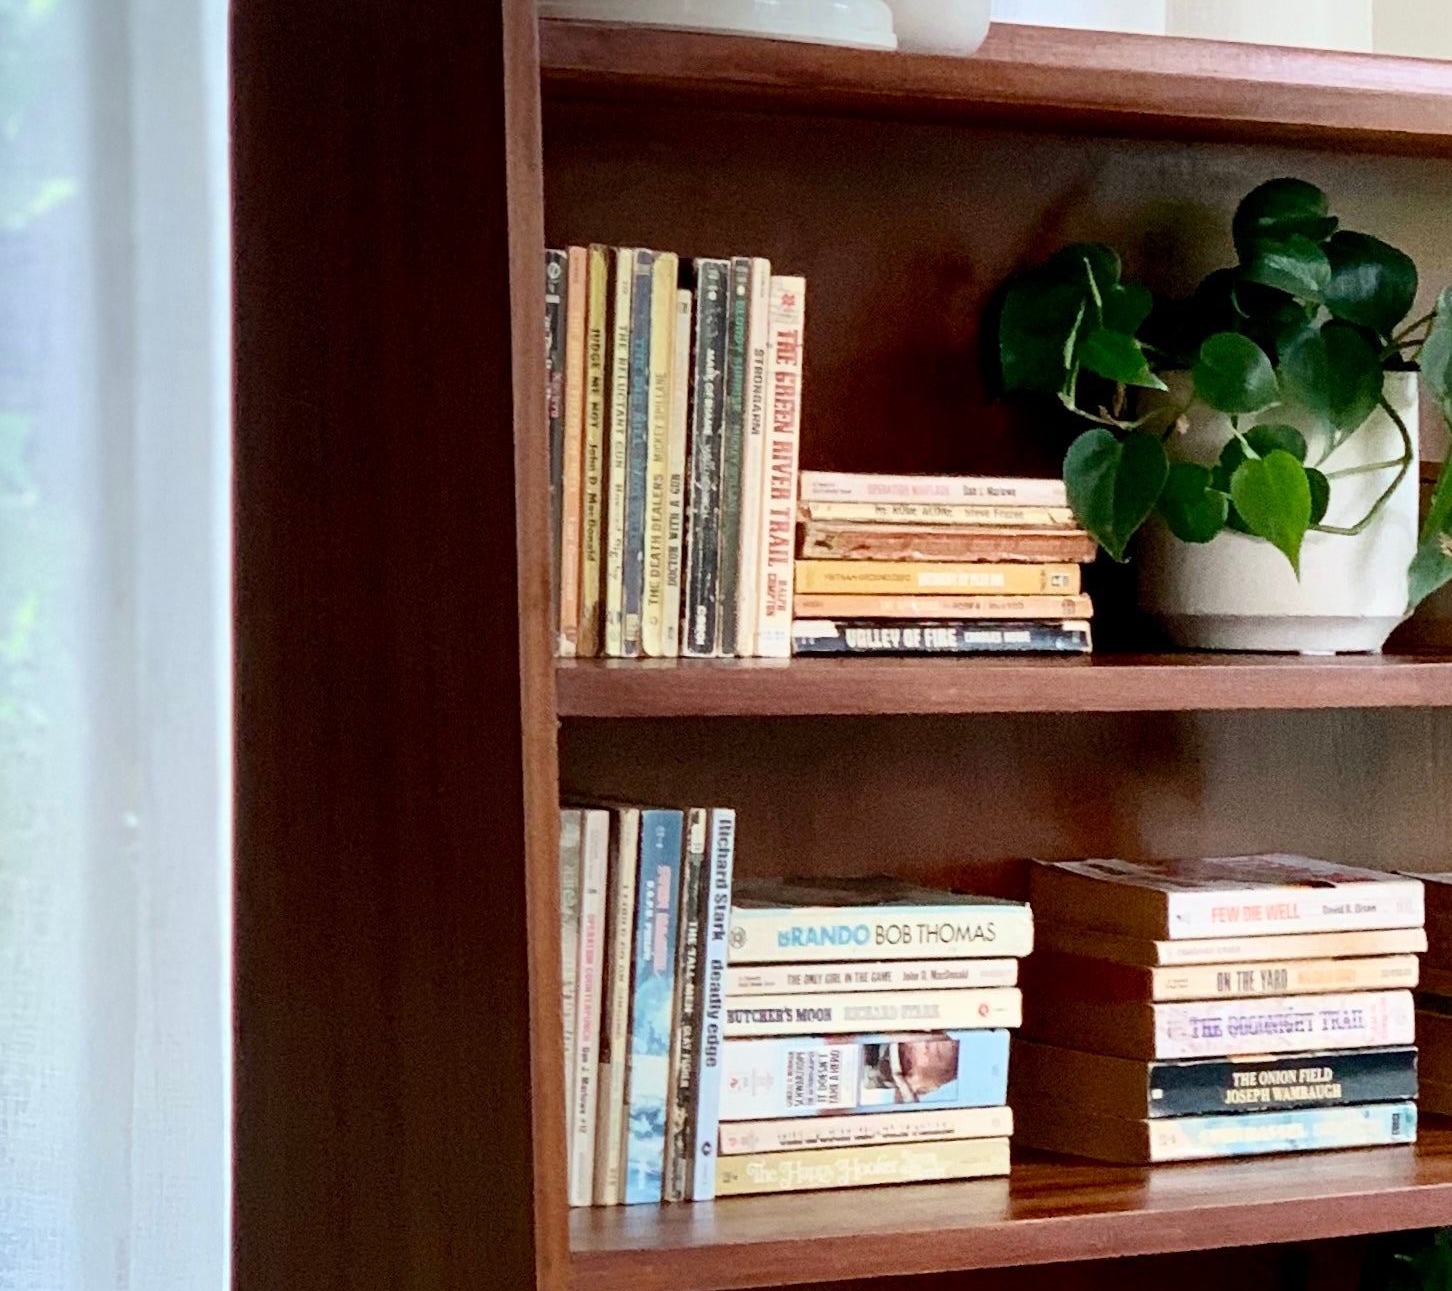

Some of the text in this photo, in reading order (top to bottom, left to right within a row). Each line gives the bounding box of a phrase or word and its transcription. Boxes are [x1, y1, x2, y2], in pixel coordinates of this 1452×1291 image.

[590, 328, 601, 368] JUDGE
[617, 326, 628, 347] THE
[590, 377, 600, 391] ME
[615, 358, 627, 435] RELUCTANT
[751, 348, 765, 436] STRONGARM
[589, 401, 600, 429] NOT
[588, 444, 599, 471] John
[768, 329, 798, 567] THE GREEN RIVER TRAIL
[671, 474, 681, 494] GUN
[652, 474, 664, 532] DEALERS
[587, 493, 598, 561] MacDonald
[669, 514, 679, 539] WITH
[650, 535, 662, 577] DEATH
[668, 546, 679, 586] DOCTOR
[649, 583, 660, 605] THE
[765, 573, 777, 616] COMPTON
[845, 627, 901, 649] VALLEY
[902, 627, 921, 648] OF
[923, 627, 958, 648] FIRE
[1210, 907, 1240, 924] FEW
[1242, 906, 1263, 922] DIE
[1266, 903, 1301, 920] WELL
[584, 914, 597, 965] OPERATION
[687, 921, 697, 944] THE
[704, 819, 732, 1067] Richard Stark deadly edge
[777, 921, 998, 948] BRANDO BOB THOMAS
[685, 947, 696, 979] TALL
[787, 974, 802, 986] THE
[803, 973, 823, 985] ONLY
[825, 972, 841, 984] GIRL
[844, 972, 853, 984] IN
[855, 971, 869, 983] THE
[871, 970, 893, 983] GAME
[1216, 972, 1231, 992] ON
[1236, 971, 1255, 991] THE
[1260, 968, 1288, 990] YARD
[582, 968, 595, 1041] COUNTERPUNCH
[726, 1007, 793, 1024] BUTCHER'S
[795, 1007, 832, 1022] MOON
[1189, 1017, 1223, 1039] THE
[581, 1047, 590, 1063] Dan
[1232, 1067, 1333, 1087] THE ONION FIELD
[579, 1076, 589, 1114] Marlowe
[1225, 1084, 1342, 1104] JOSEPH WAMBAUGH
[745, 1158, 778, 1184] The
